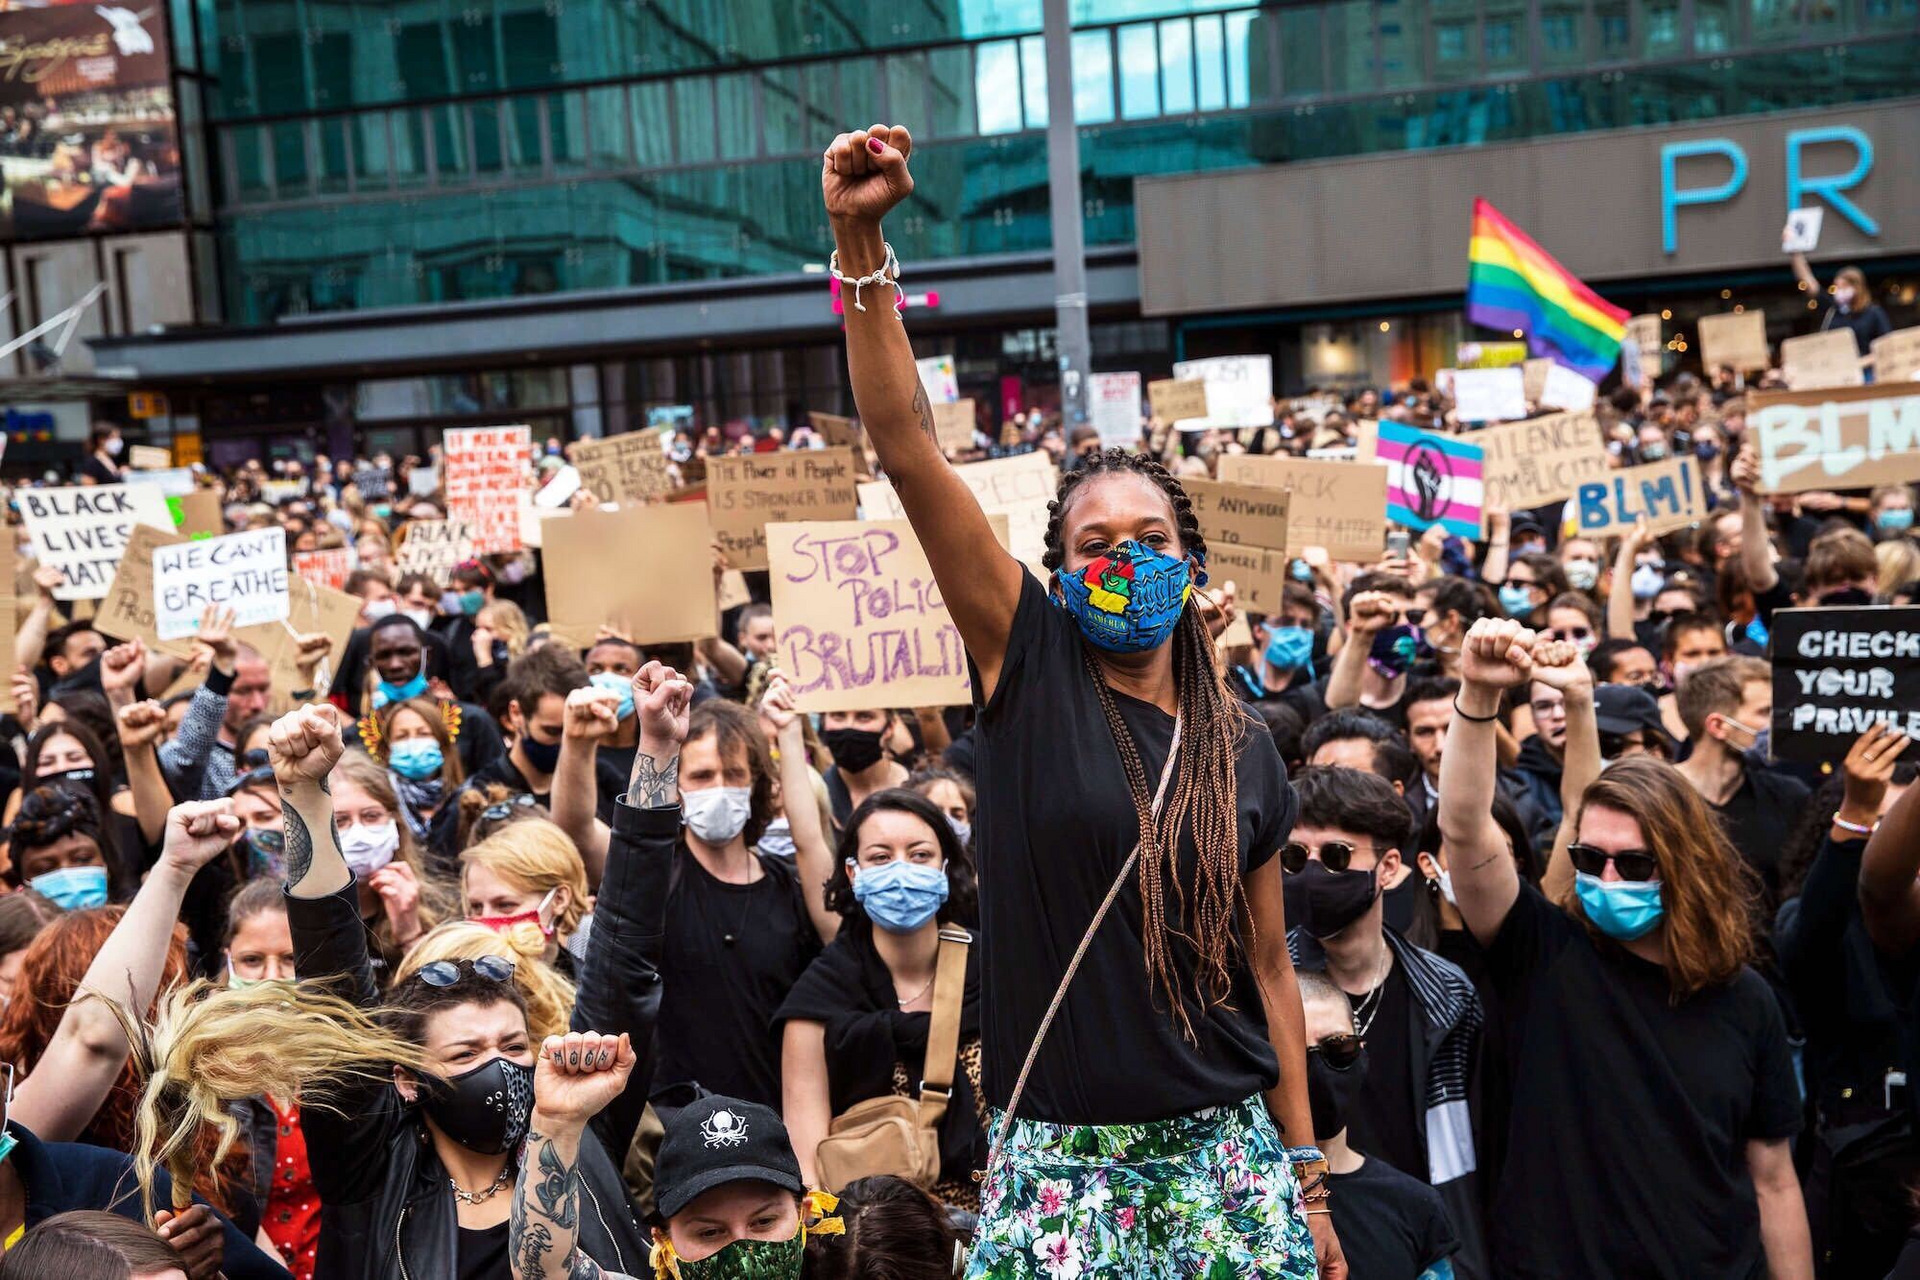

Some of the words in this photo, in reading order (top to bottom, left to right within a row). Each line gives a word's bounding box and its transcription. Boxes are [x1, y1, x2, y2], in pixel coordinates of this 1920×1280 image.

[1758, 400, 1920, 491] BLM
[27, 491, 134, 518] BLACK
[1579, 462, 1692, 528] BLM!
[42, 523, 132, 551] LIVES
[1220, 528, 1241, 544] TO
[56, 557, 122, 586] MATT
[162, 549, 202, 575] WE
[786, 529, 899, 583] STOP
[164, 568, 288, 611] BREATHE
[838, 578, 944, 627] POLiC
[779, 624, 970, 694] BRUTALIT
[1797, 630, 1920, 659] CHECK
[1794, 666, 1896, 700] YOUR
